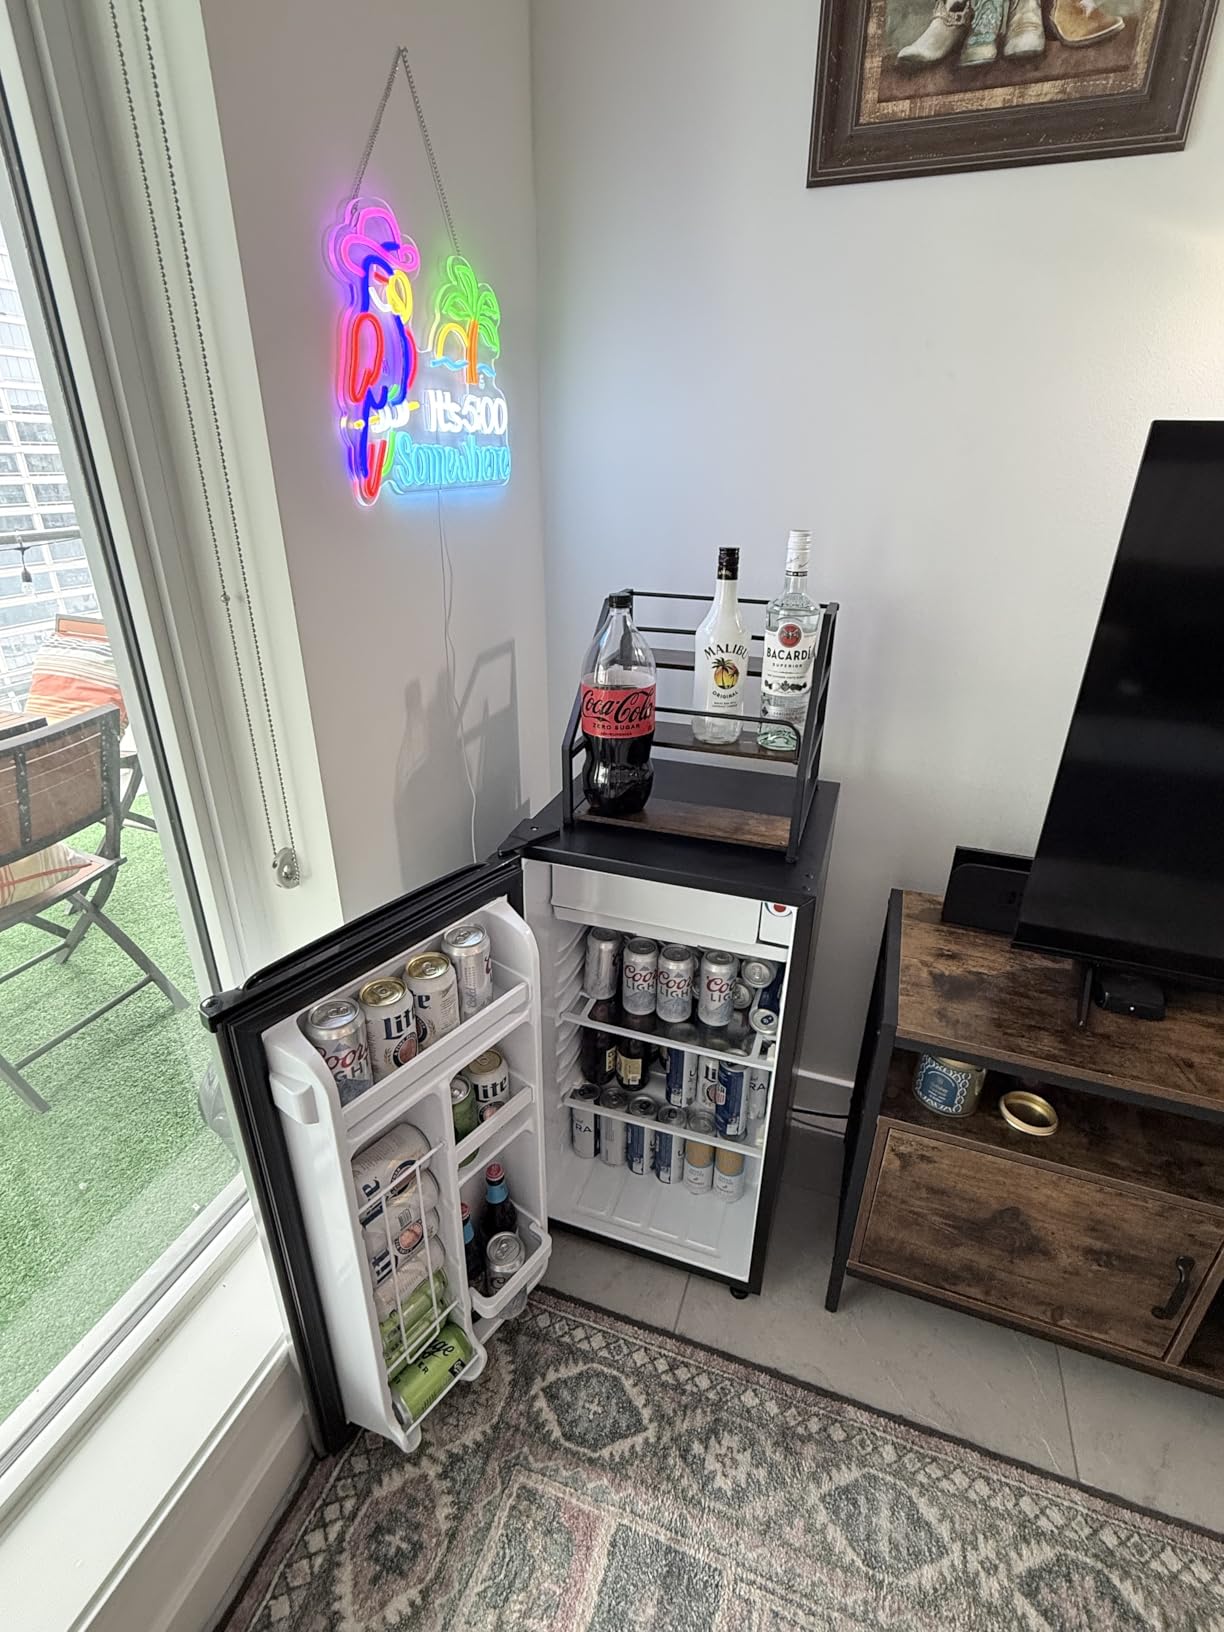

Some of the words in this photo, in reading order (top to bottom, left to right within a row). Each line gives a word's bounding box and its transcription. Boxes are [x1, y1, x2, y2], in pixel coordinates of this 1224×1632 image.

[393, 431, 511, 486] Somewhere
[704, 643, 749, 660] MALIBU
[712, 690, 739, 699] ORIGINAL
[582, 688, 656, 724] Coca-Cola
[593, 722, 612, 731] ZERO
[614, 722, 641, 731] SUGAR
[626, 980, 656, 991] LIGH
[660, 986, 690, 999] LIGH
[383, 1008, 416, 1041] Lit
[473, 1076, 507, 1103] Lite
